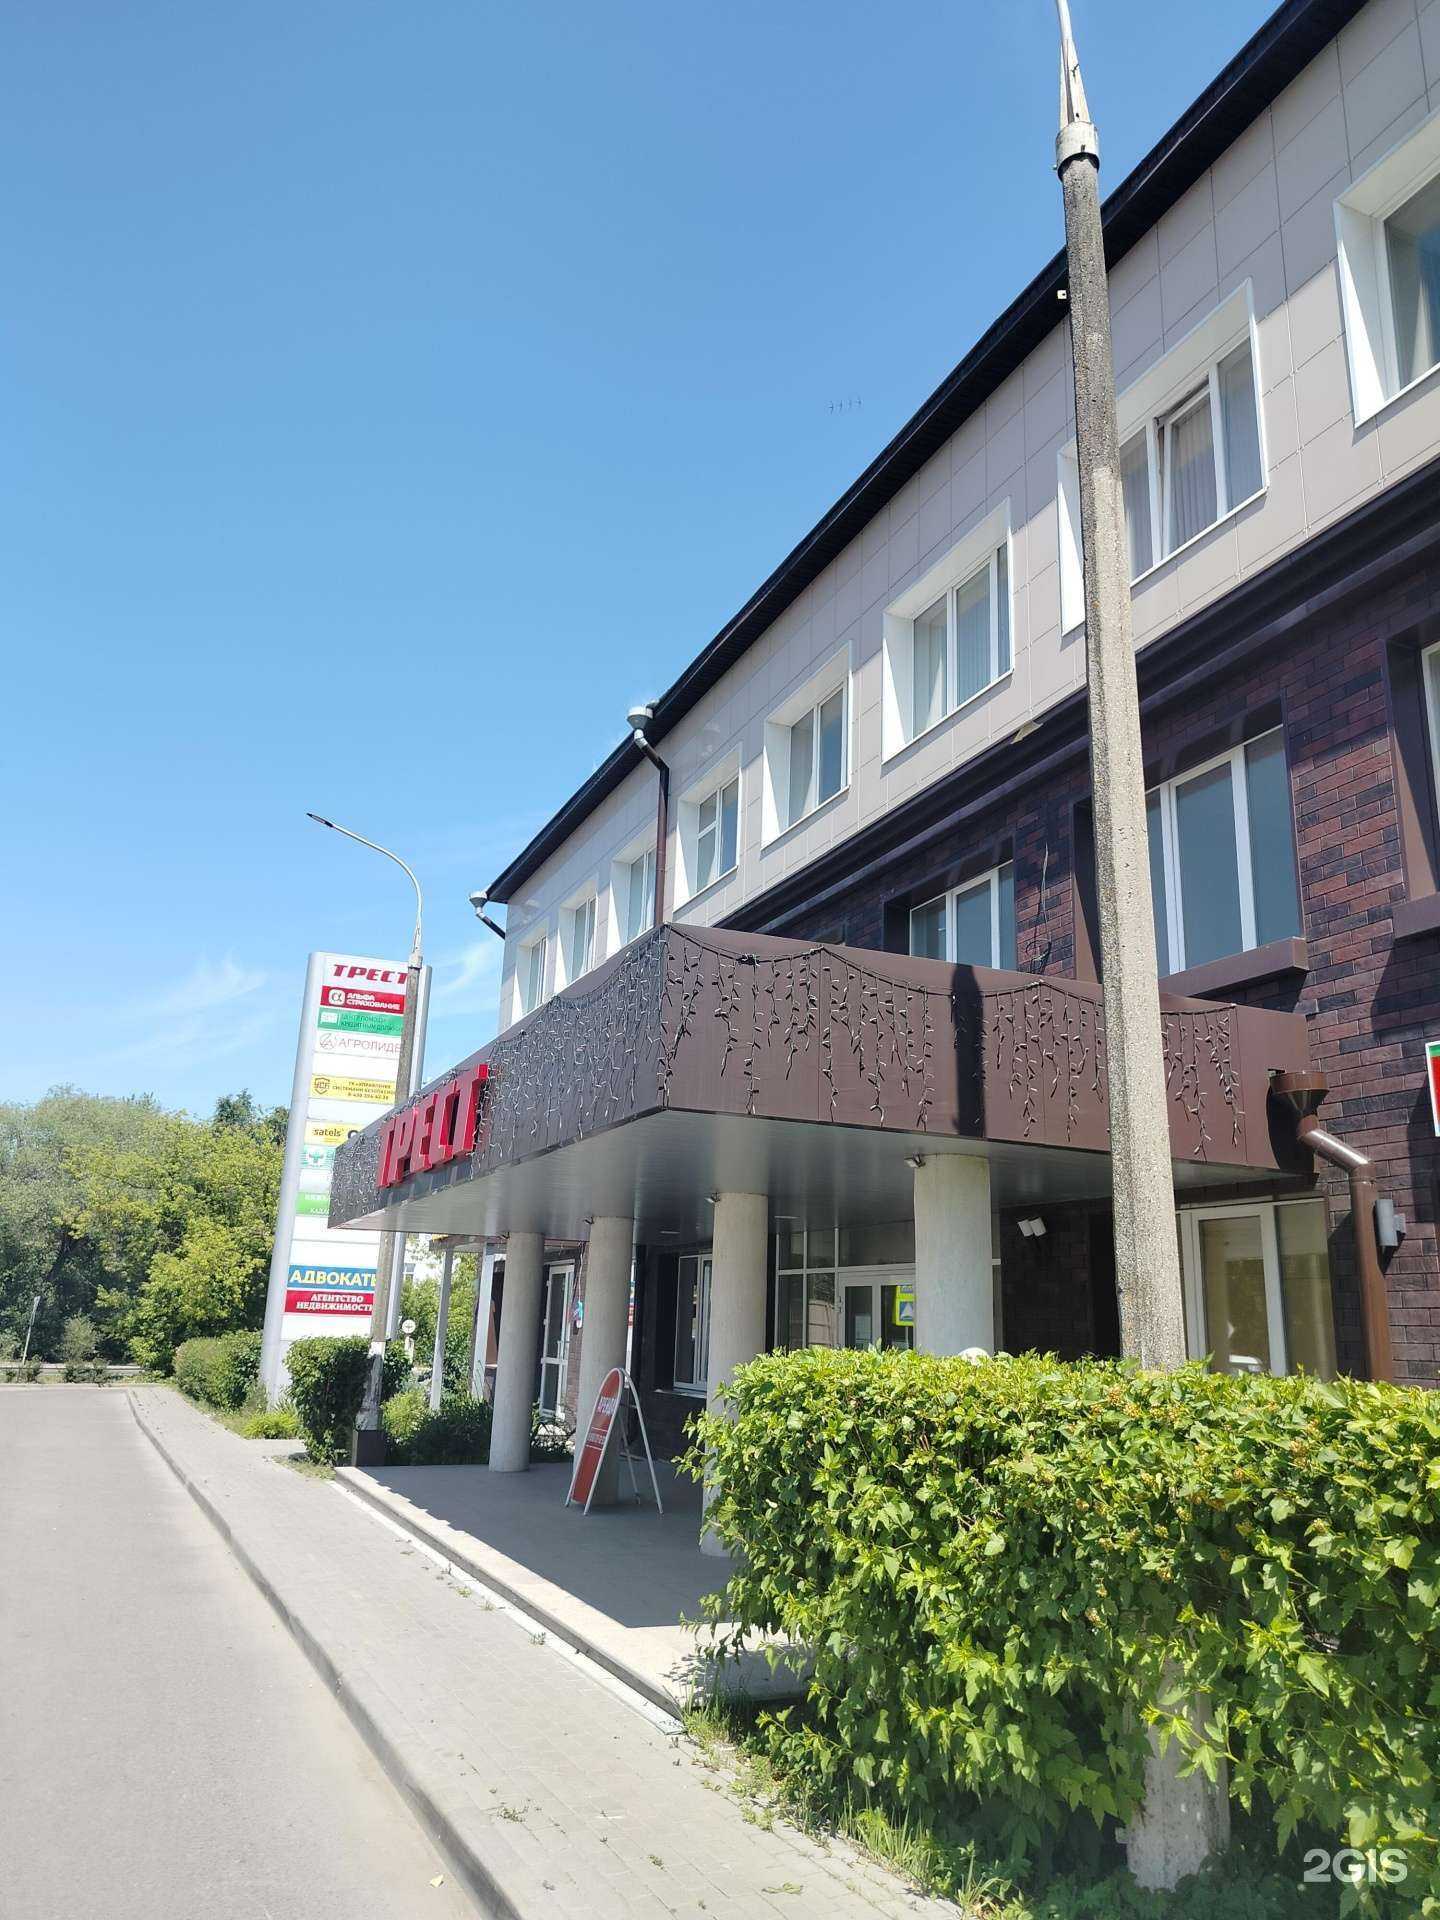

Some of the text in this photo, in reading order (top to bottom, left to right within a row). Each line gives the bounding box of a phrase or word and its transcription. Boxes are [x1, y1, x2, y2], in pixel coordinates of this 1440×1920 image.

[333, 964, 408, 984] ТРЕСТ
[338, 1038, 401, 1053] АГРОЛИДЕ
[377, 1064, 489, 1189] ТРЕСТ
[311, 1293, 364, 1303] АГЕНТСТВО
